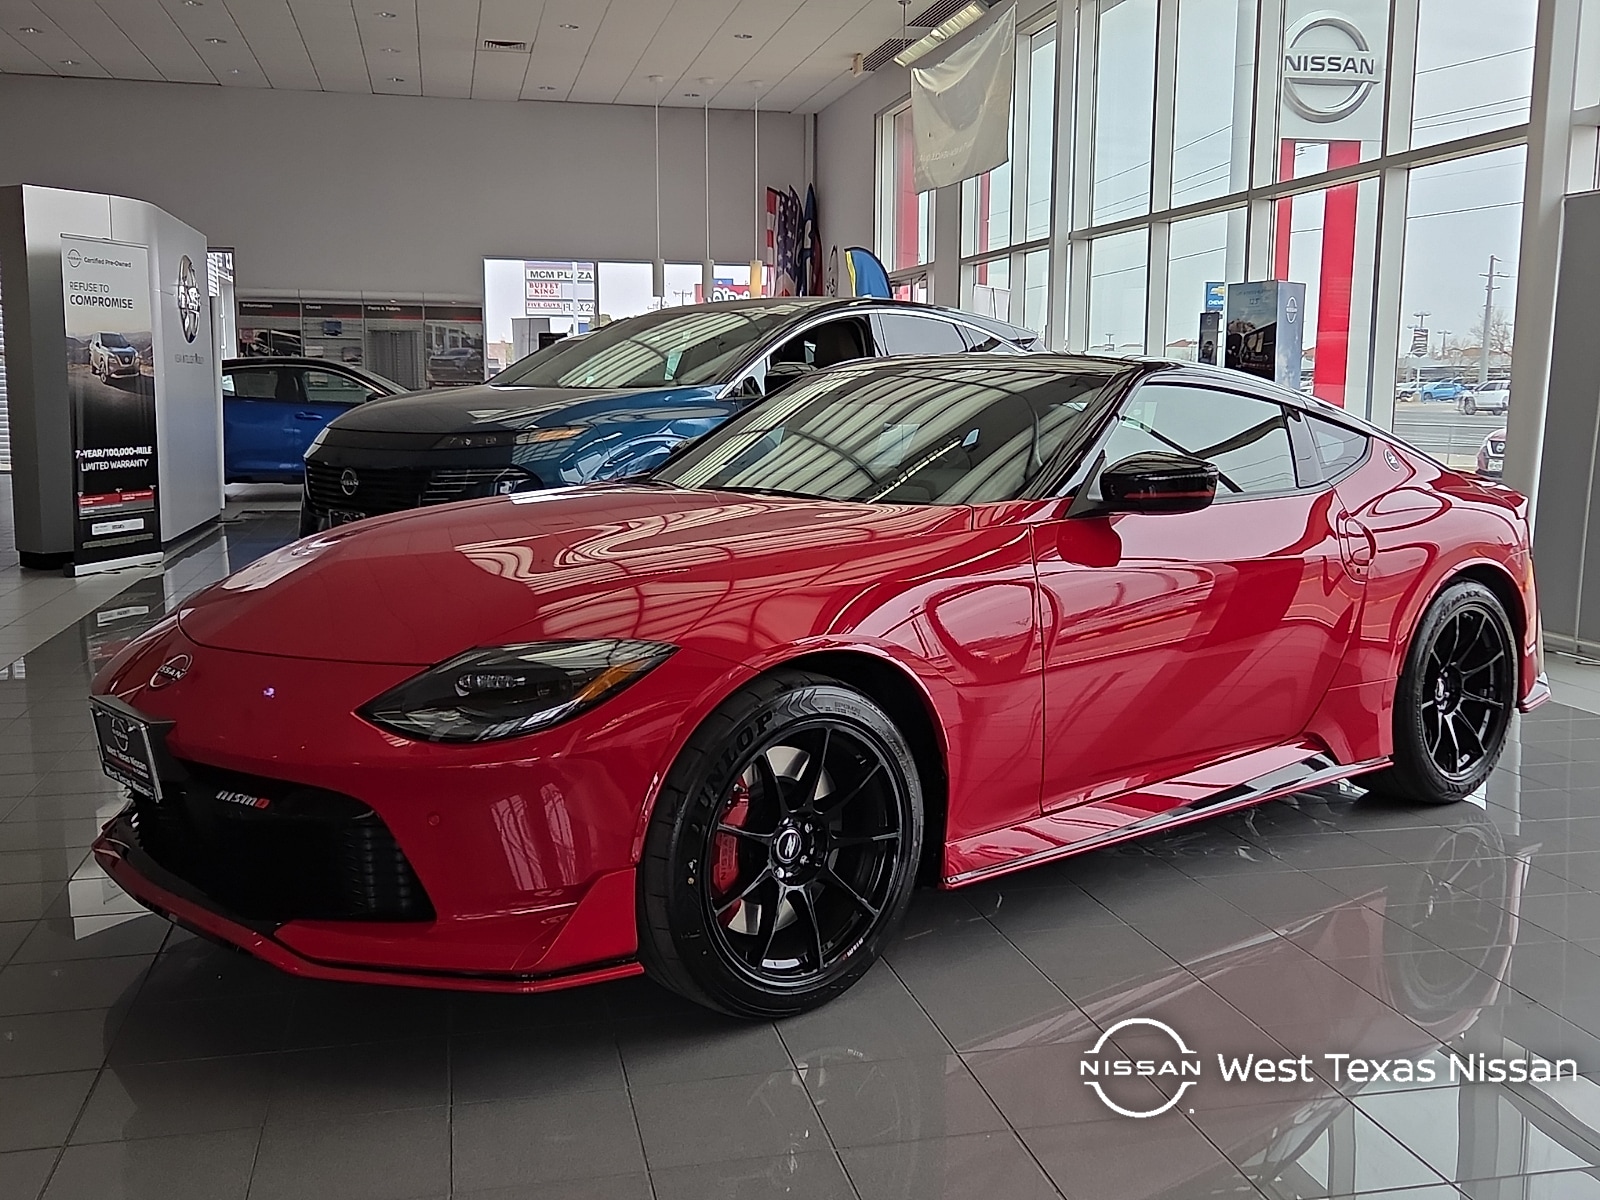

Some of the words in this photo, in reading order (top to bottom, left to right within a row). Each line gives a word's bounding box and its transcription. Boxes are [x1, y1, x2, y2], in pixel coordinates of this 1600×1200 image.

[1284, 55, 1374, 75] NISSAN
[530, 271, 555, 279] MCM
[69, 281, 98, 293] REFUSE
[99, 284, 110, 293] TO
[69, 294, 134, 309] COMPROMISE
[74, 446, 153, 460] 7-YEAR/100,000-MILE
[80, 461, 110, 472] LIMITED
[110, 458, 149, 470] WARRANTY
[160, 665, 184, 679] SSAN
